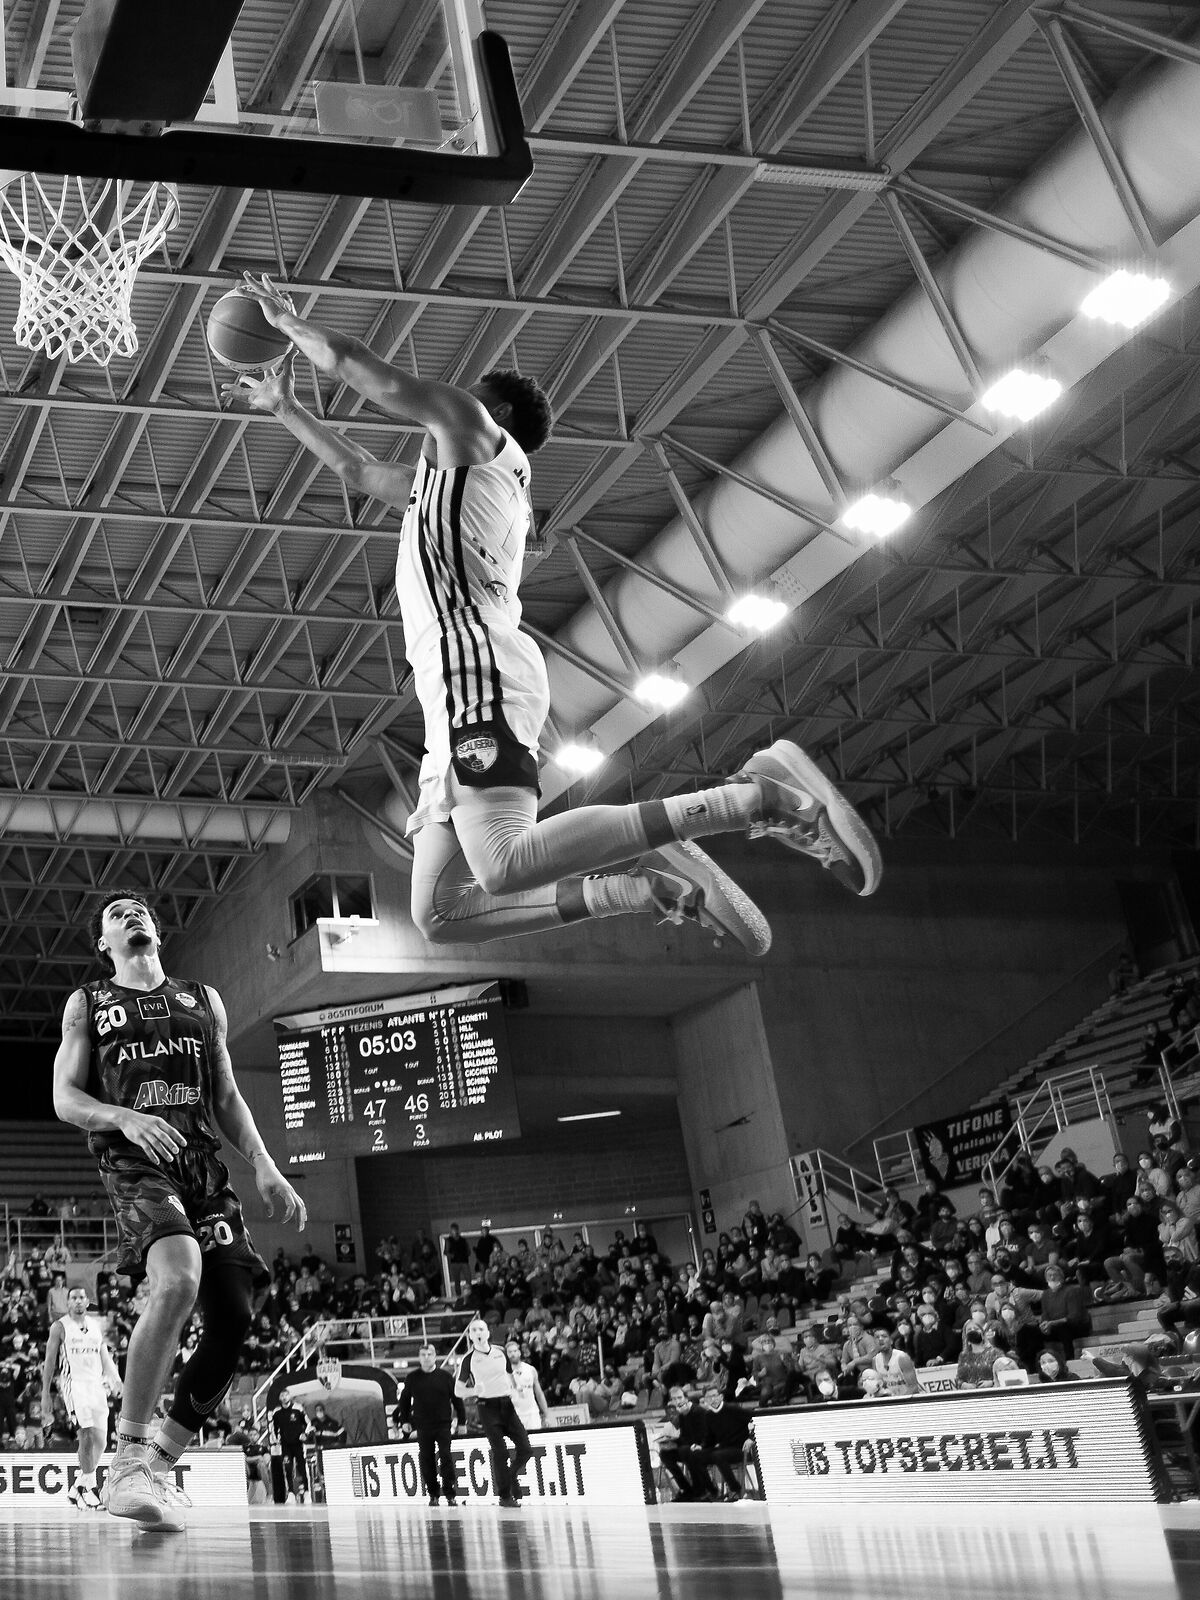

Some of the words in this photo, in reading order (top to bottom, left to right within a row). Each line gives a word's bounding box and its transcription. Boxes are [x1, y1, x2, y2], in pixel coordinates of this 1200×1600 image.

[458, 739, 496, 752] SCALIGERA
[143, 1003, 164, 1011] EVR
[94, 1005, 127, 1036] 20
[349, 1020, 383, 1033] TEZENIS
[387, 1012, 425, 1027] ATLANTE
[117, 1036, 203, 1065] ATLANTE
[359, 1030, 416, 1057] 05:03
[363, 1099, 387, 1119] 47
[404, 1093, 429, 1113] 46
[416, 1124, 426, 1139] 3
[947, 1108, 1003, 1139] TIFONE
[373, 1129, 384, 1144] 2
[484, 1129, 503, 1140] PILOT
[956, 1148, 1010, 1173] VERONA
[196, 1220, 234, 1253] 20
[835, 1427, 1080, 1474] TOPSECRET.IT
